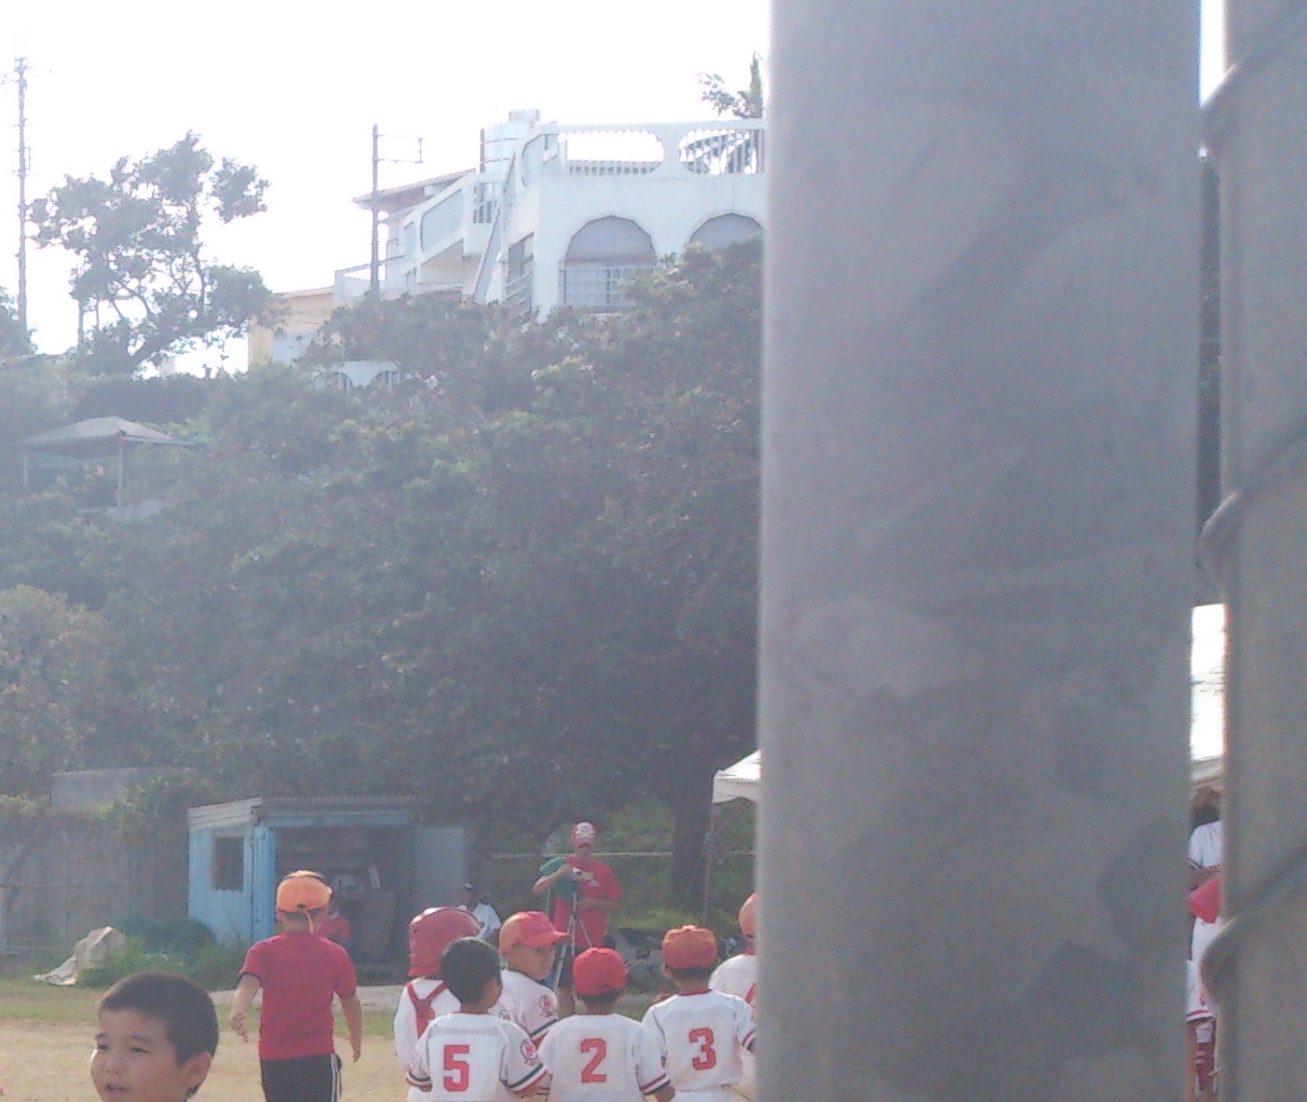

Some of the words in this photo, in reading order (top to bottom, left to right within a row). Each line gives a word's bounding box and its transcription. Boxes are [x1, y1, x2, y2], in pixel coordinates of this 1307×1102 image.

[443, 1044, 471, 1092] 5
[580, 1038, 608, 1084] 2
[688, 1027, 717, 1071] 3
